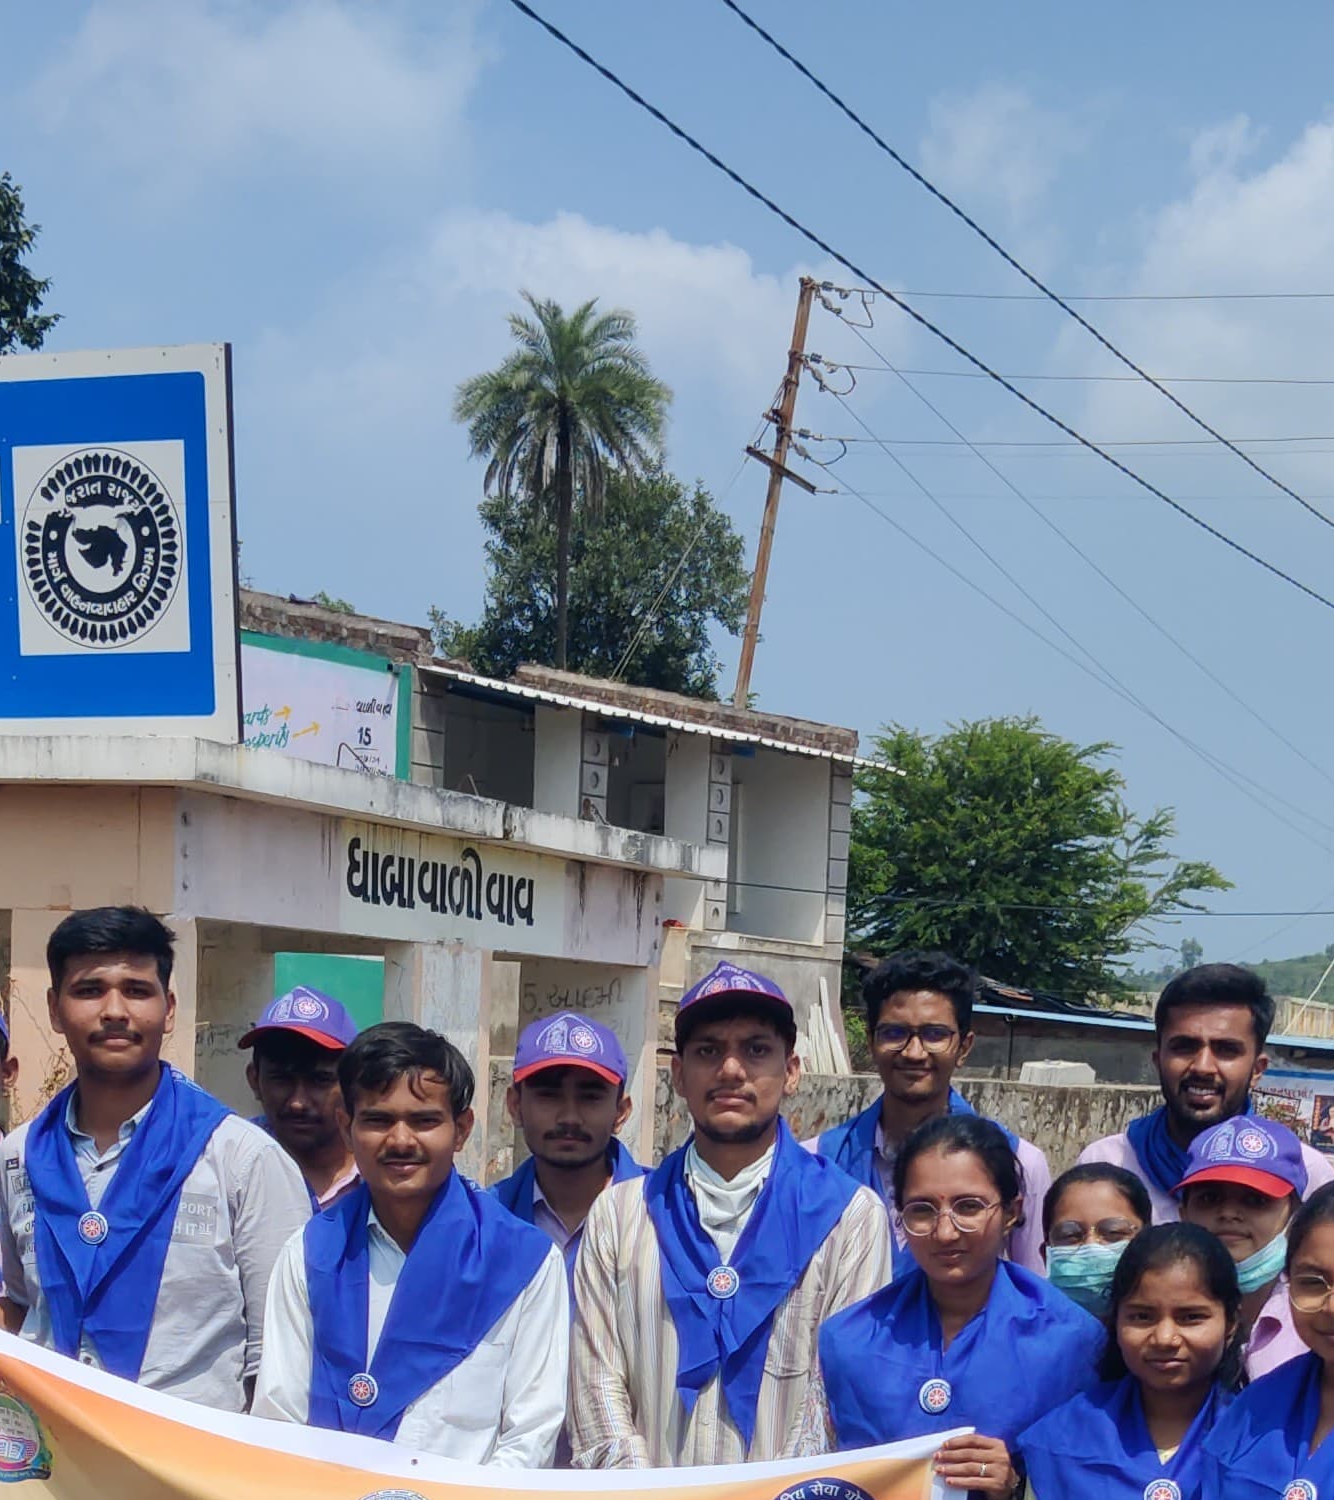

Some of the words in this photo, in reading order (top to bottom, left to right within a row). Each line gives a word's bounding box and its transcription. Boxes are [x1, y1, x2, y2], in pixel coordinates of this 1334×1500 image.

[357, 726, 372, 746] 15
[346, 836, 535, 926] ધાબાવાળીવાવ
[808, 1481, 841, 1497] सेवा
